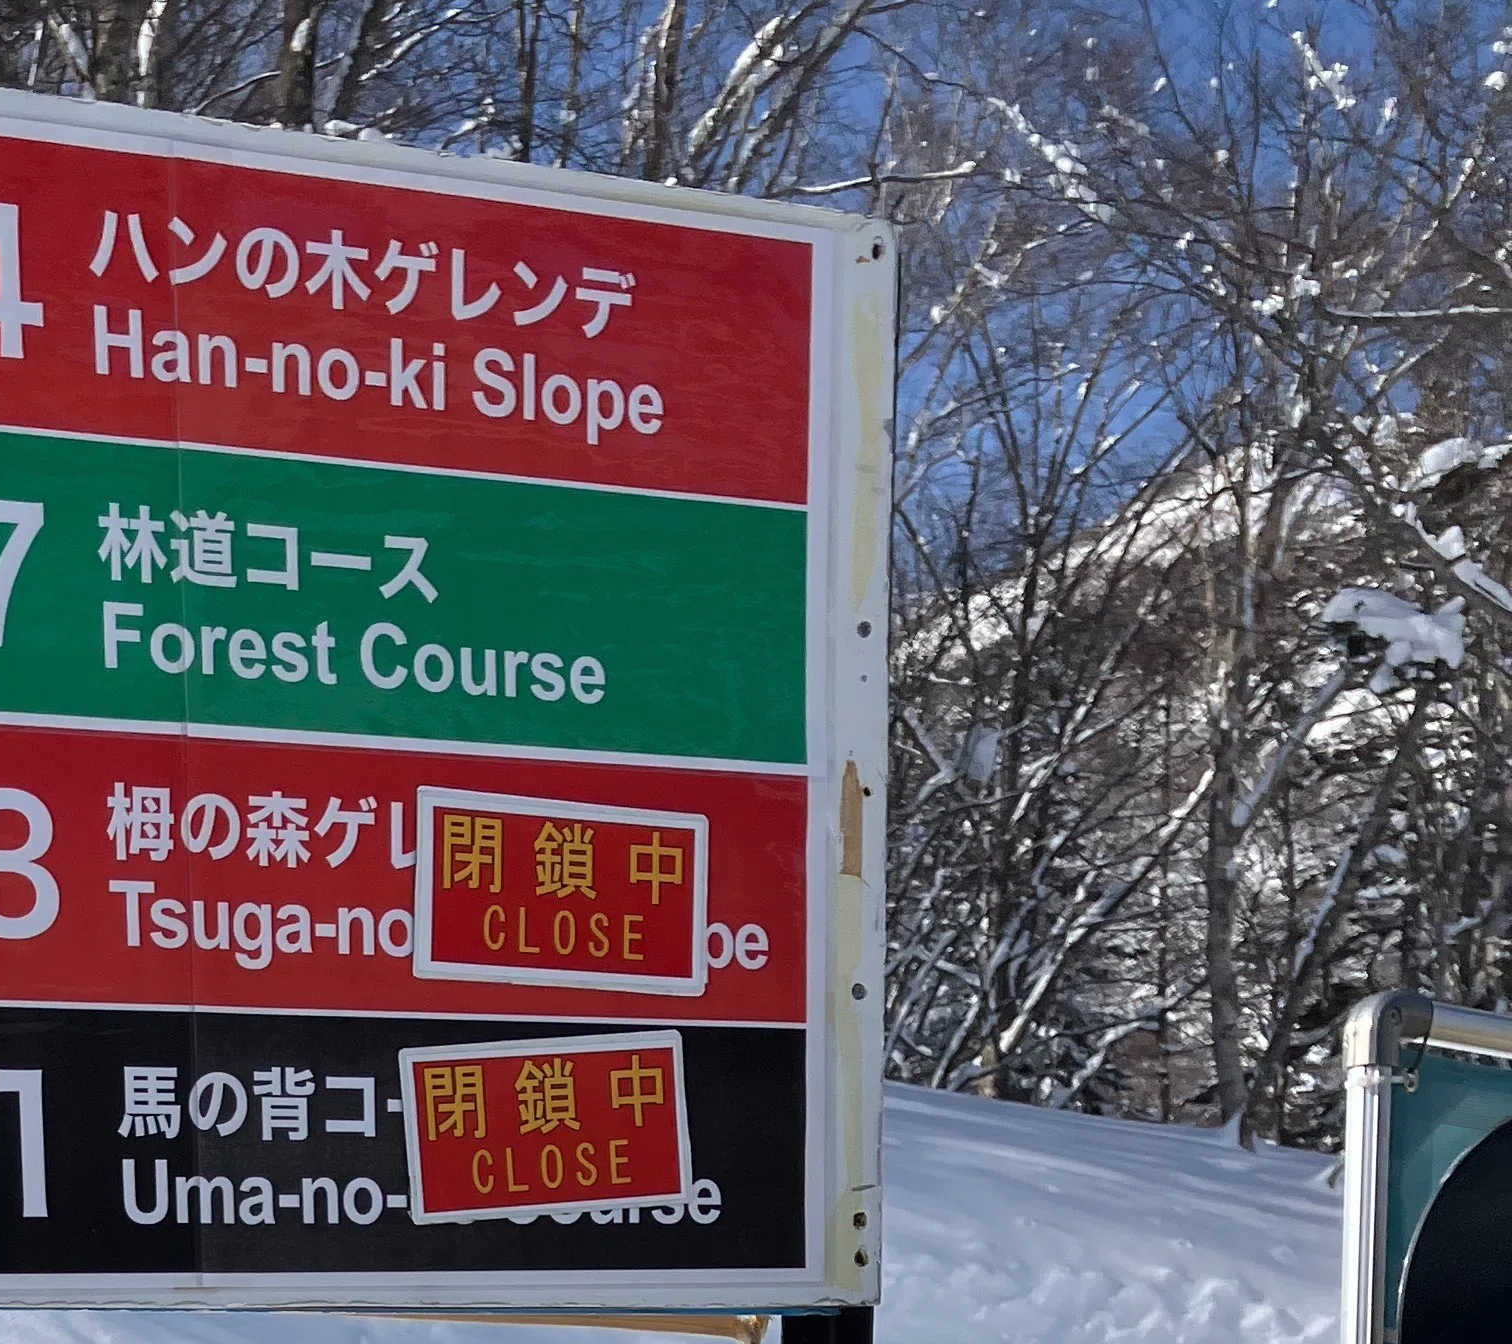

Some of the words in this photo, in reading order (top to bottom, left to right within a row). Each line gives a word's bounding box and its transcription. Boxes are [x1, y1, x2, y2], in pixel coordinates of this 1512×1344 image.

[89, 210, 636, 341] ハンの木ゲレンデ
[93, 304, 446, 412] Han-no-ki
[472, 348, 665, 445] Slope
[98, 502, 439, 603] 林道コース
[101, 602, 338, 685] Forest
[360, 622, 607, 705] Course
[442, 815, 684, 905] 閉鎖中
[483, 905, 645, 961] CLOSE
[118, 1066, 402, 1141] 馬の背コ
[423, 1055, 665, 1141] 閉鎖中
[472, 1139, 632, 1194] CLOSE
